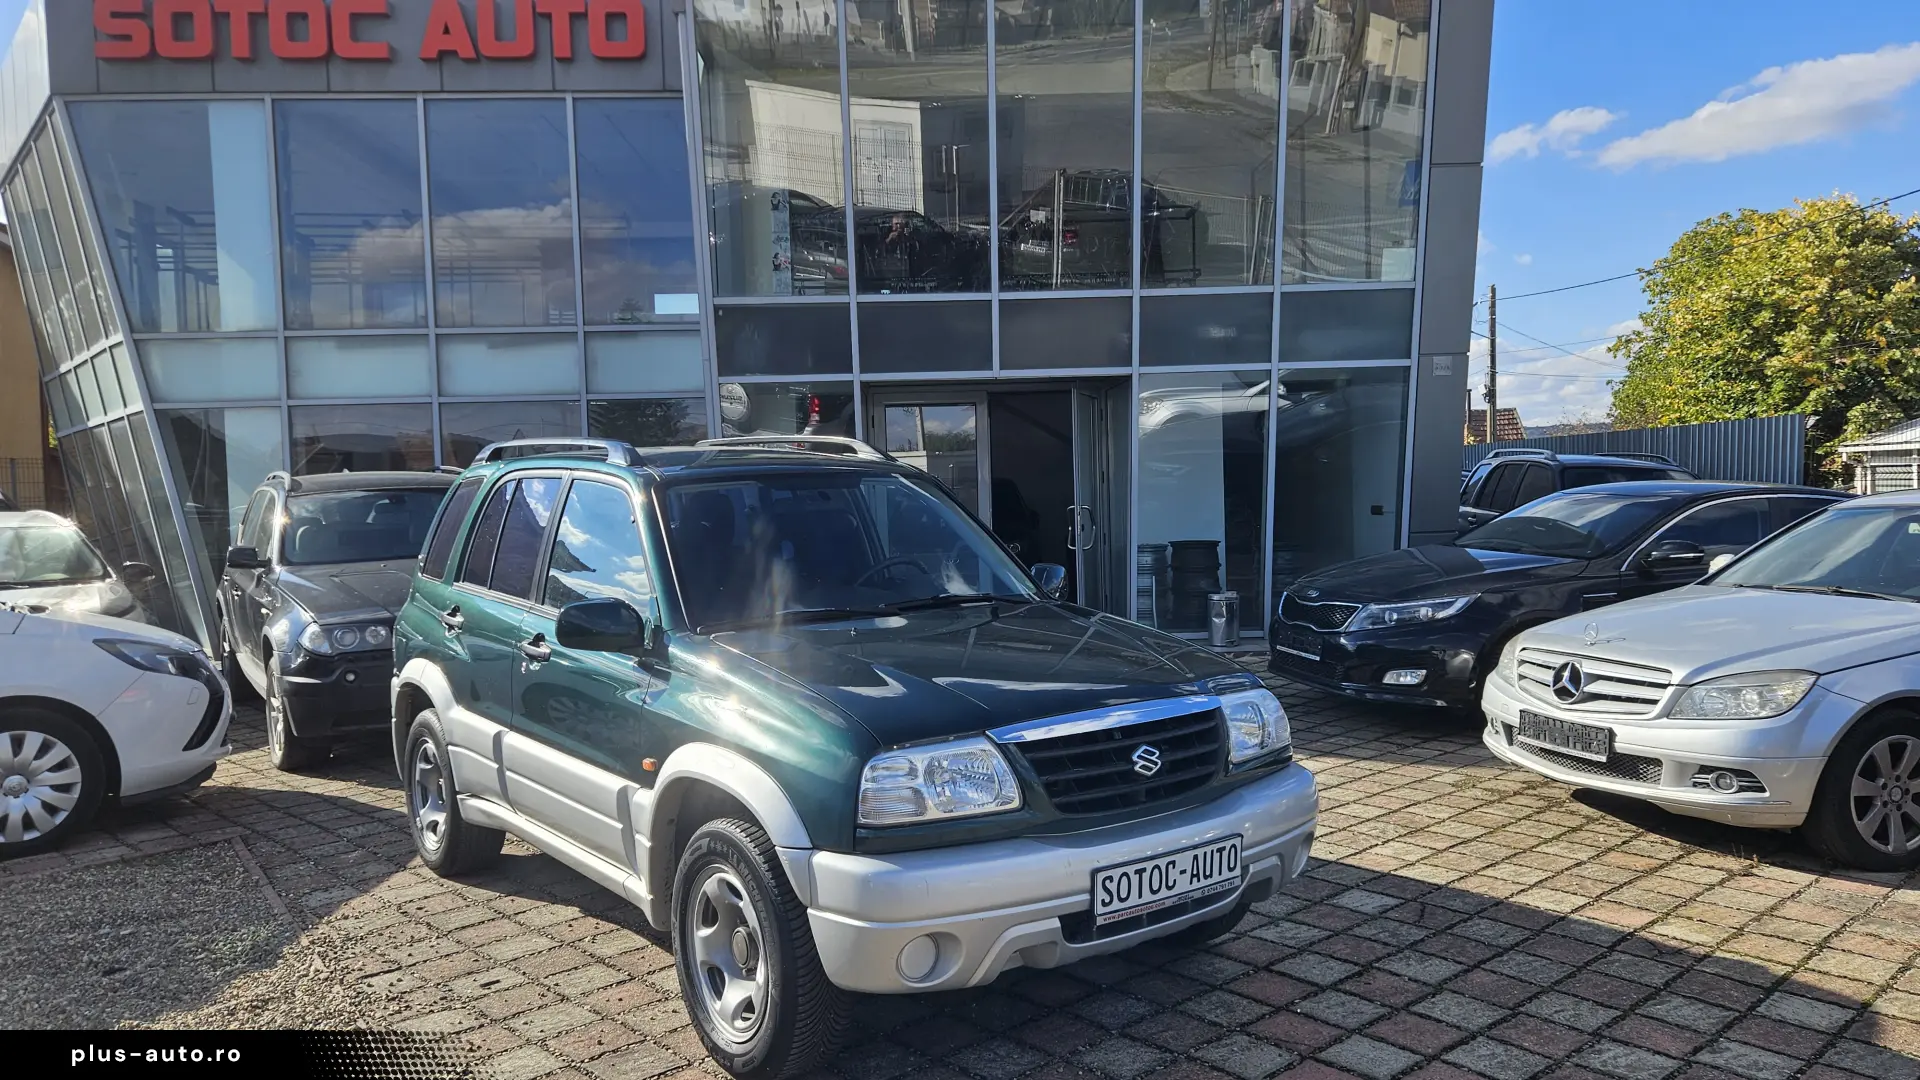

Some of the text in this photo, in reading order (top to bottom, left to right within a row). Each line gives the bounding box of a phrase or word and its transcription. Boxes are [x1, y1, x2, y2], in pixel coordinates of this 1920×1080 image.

[93, 0, 646, 60] SOTOC AUTO
[1101, 843, 1238, 907] SOTOC-AUTO
